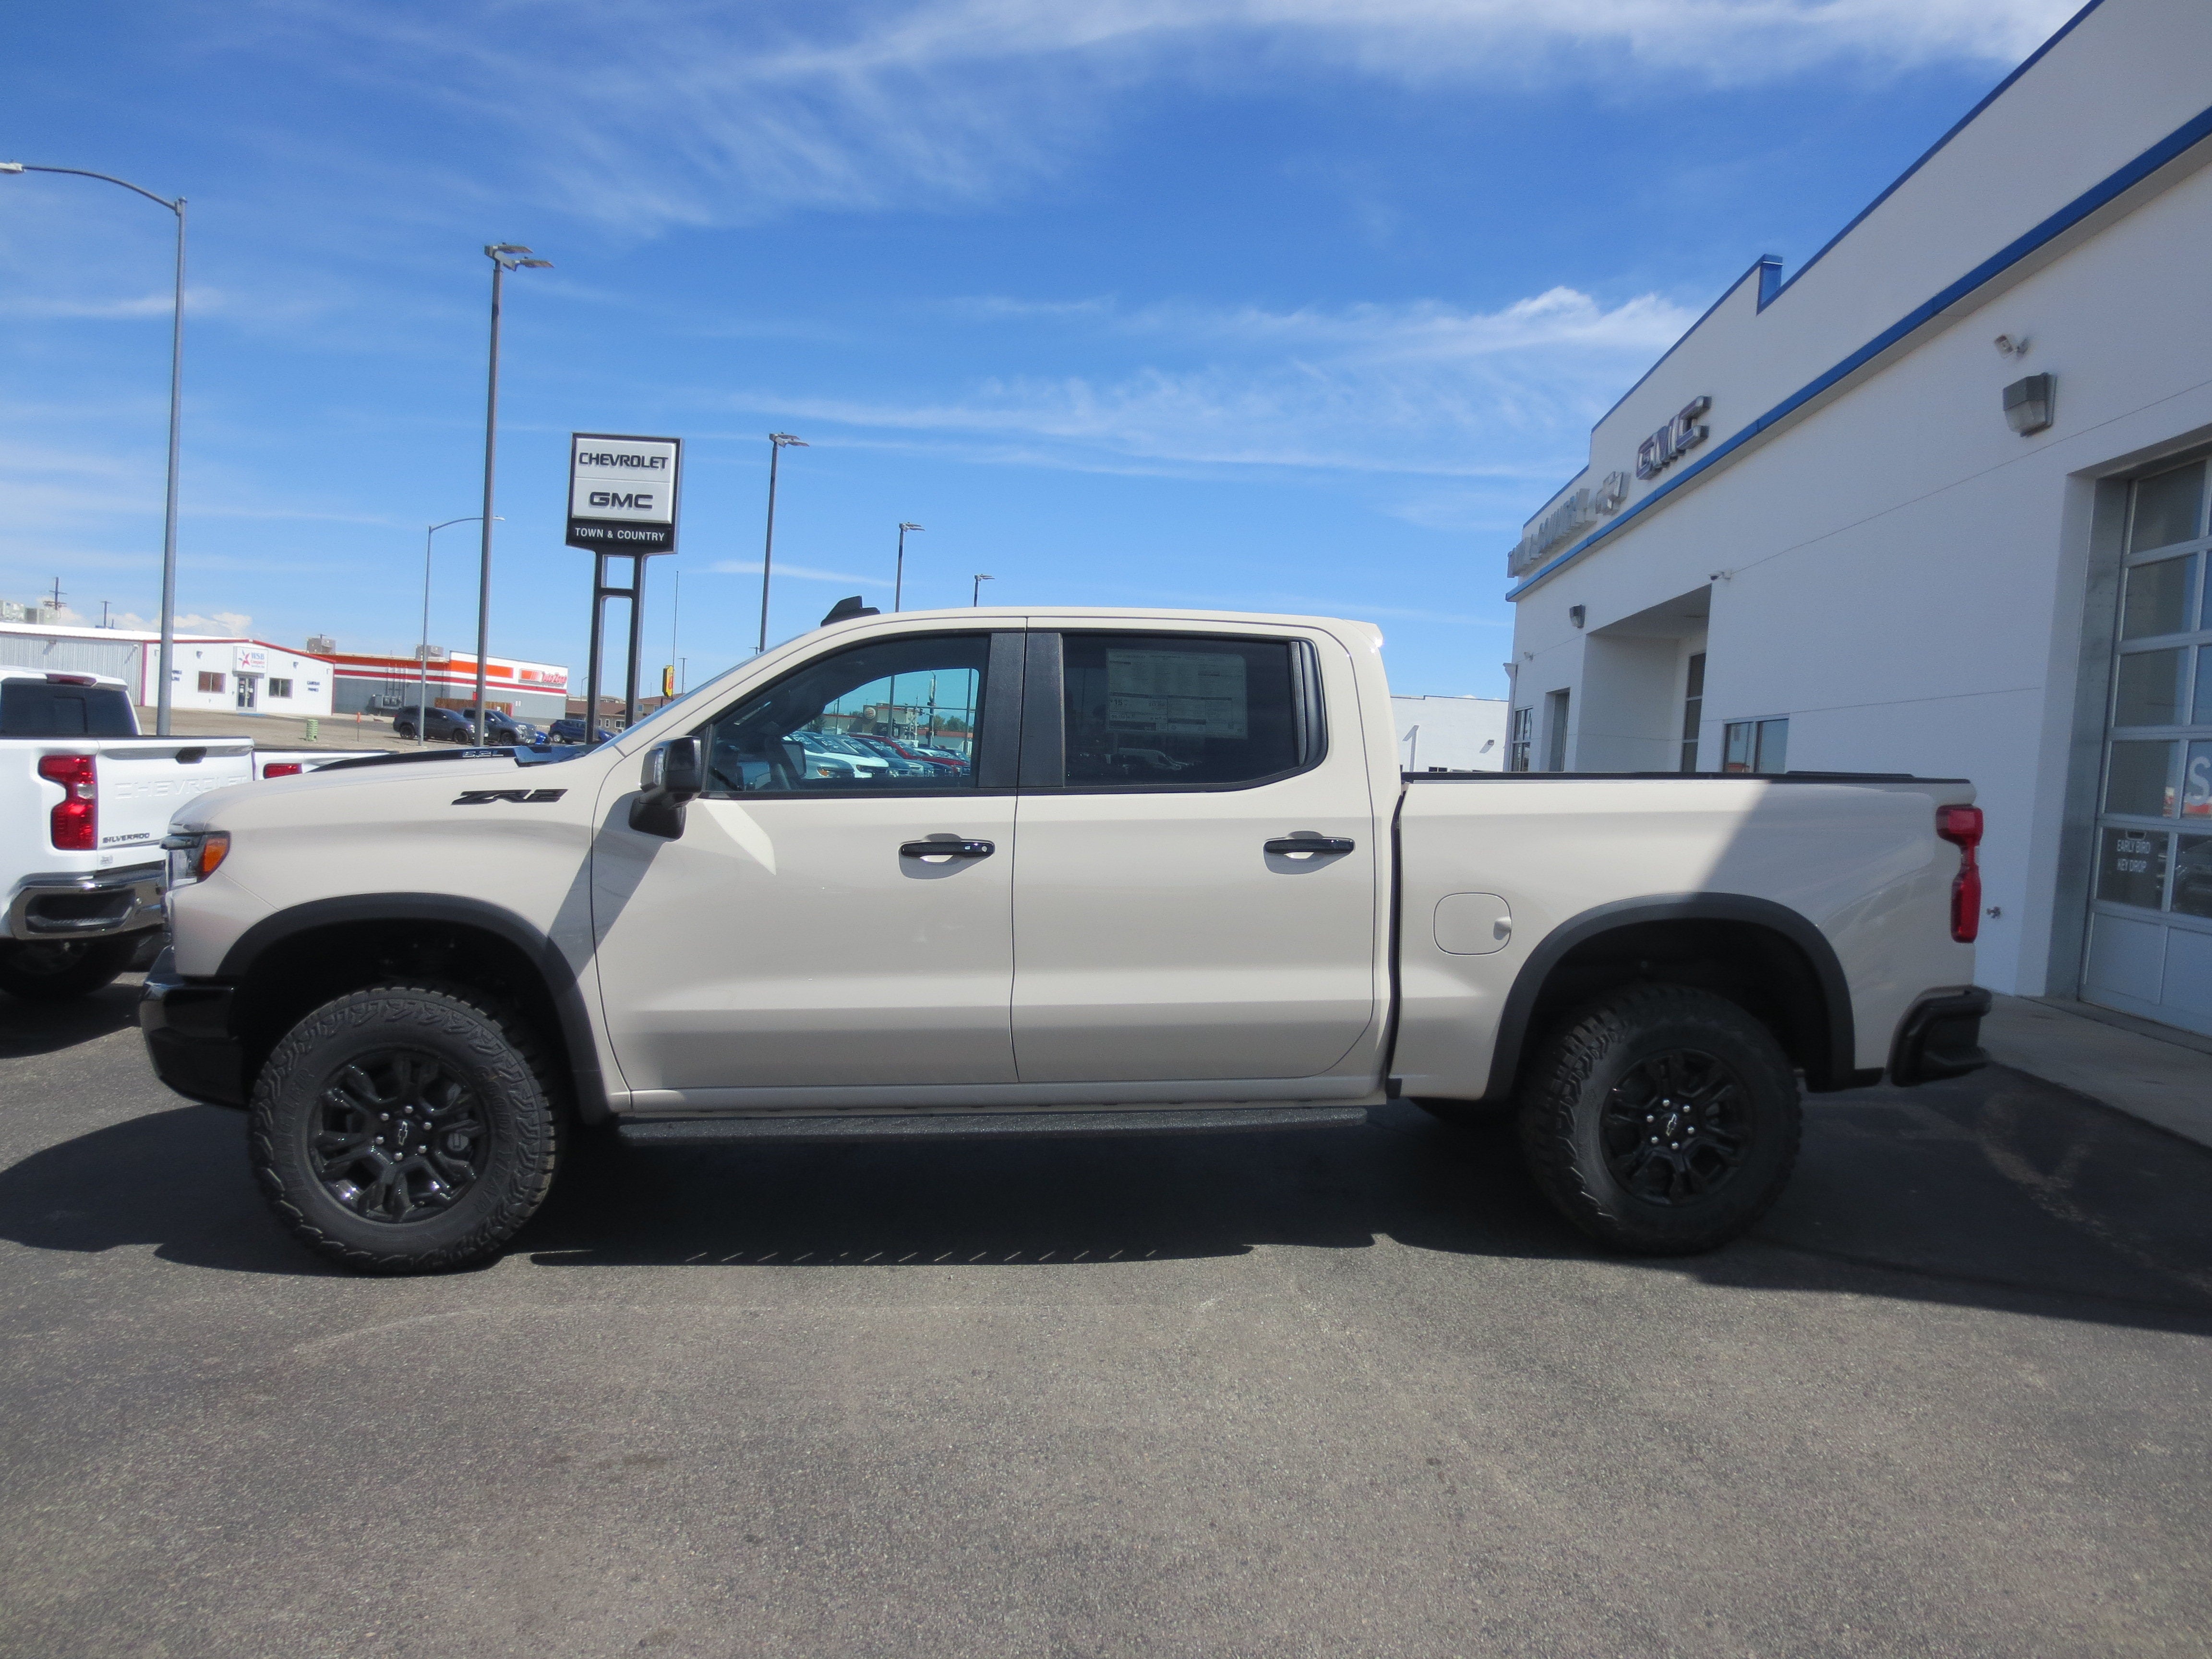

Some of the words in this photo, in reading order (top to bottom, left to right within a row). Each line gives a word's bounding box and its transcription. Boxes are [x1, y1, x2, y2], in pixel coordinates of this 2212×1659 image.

[1636, 395, 1712, 481] GMC
[579, 452, 669, 469] CHEVROLET
[589, 492, 653, 509] GMC
[575, 527, 603, 538] TOWN
[607, 530, 613, 539] &
[617, 529, 664, 541] COUNTRY
[450, 789, 568, 806] ZR2
[102, 833, 150, 843] SILVERADO
[2117, 839, 2134, 853] EARLY
[2135, 841, 2151, 854] BIRD
[2117, 858, 2128, 871] KEY
[2129, 859, 2147, 873] DROP
